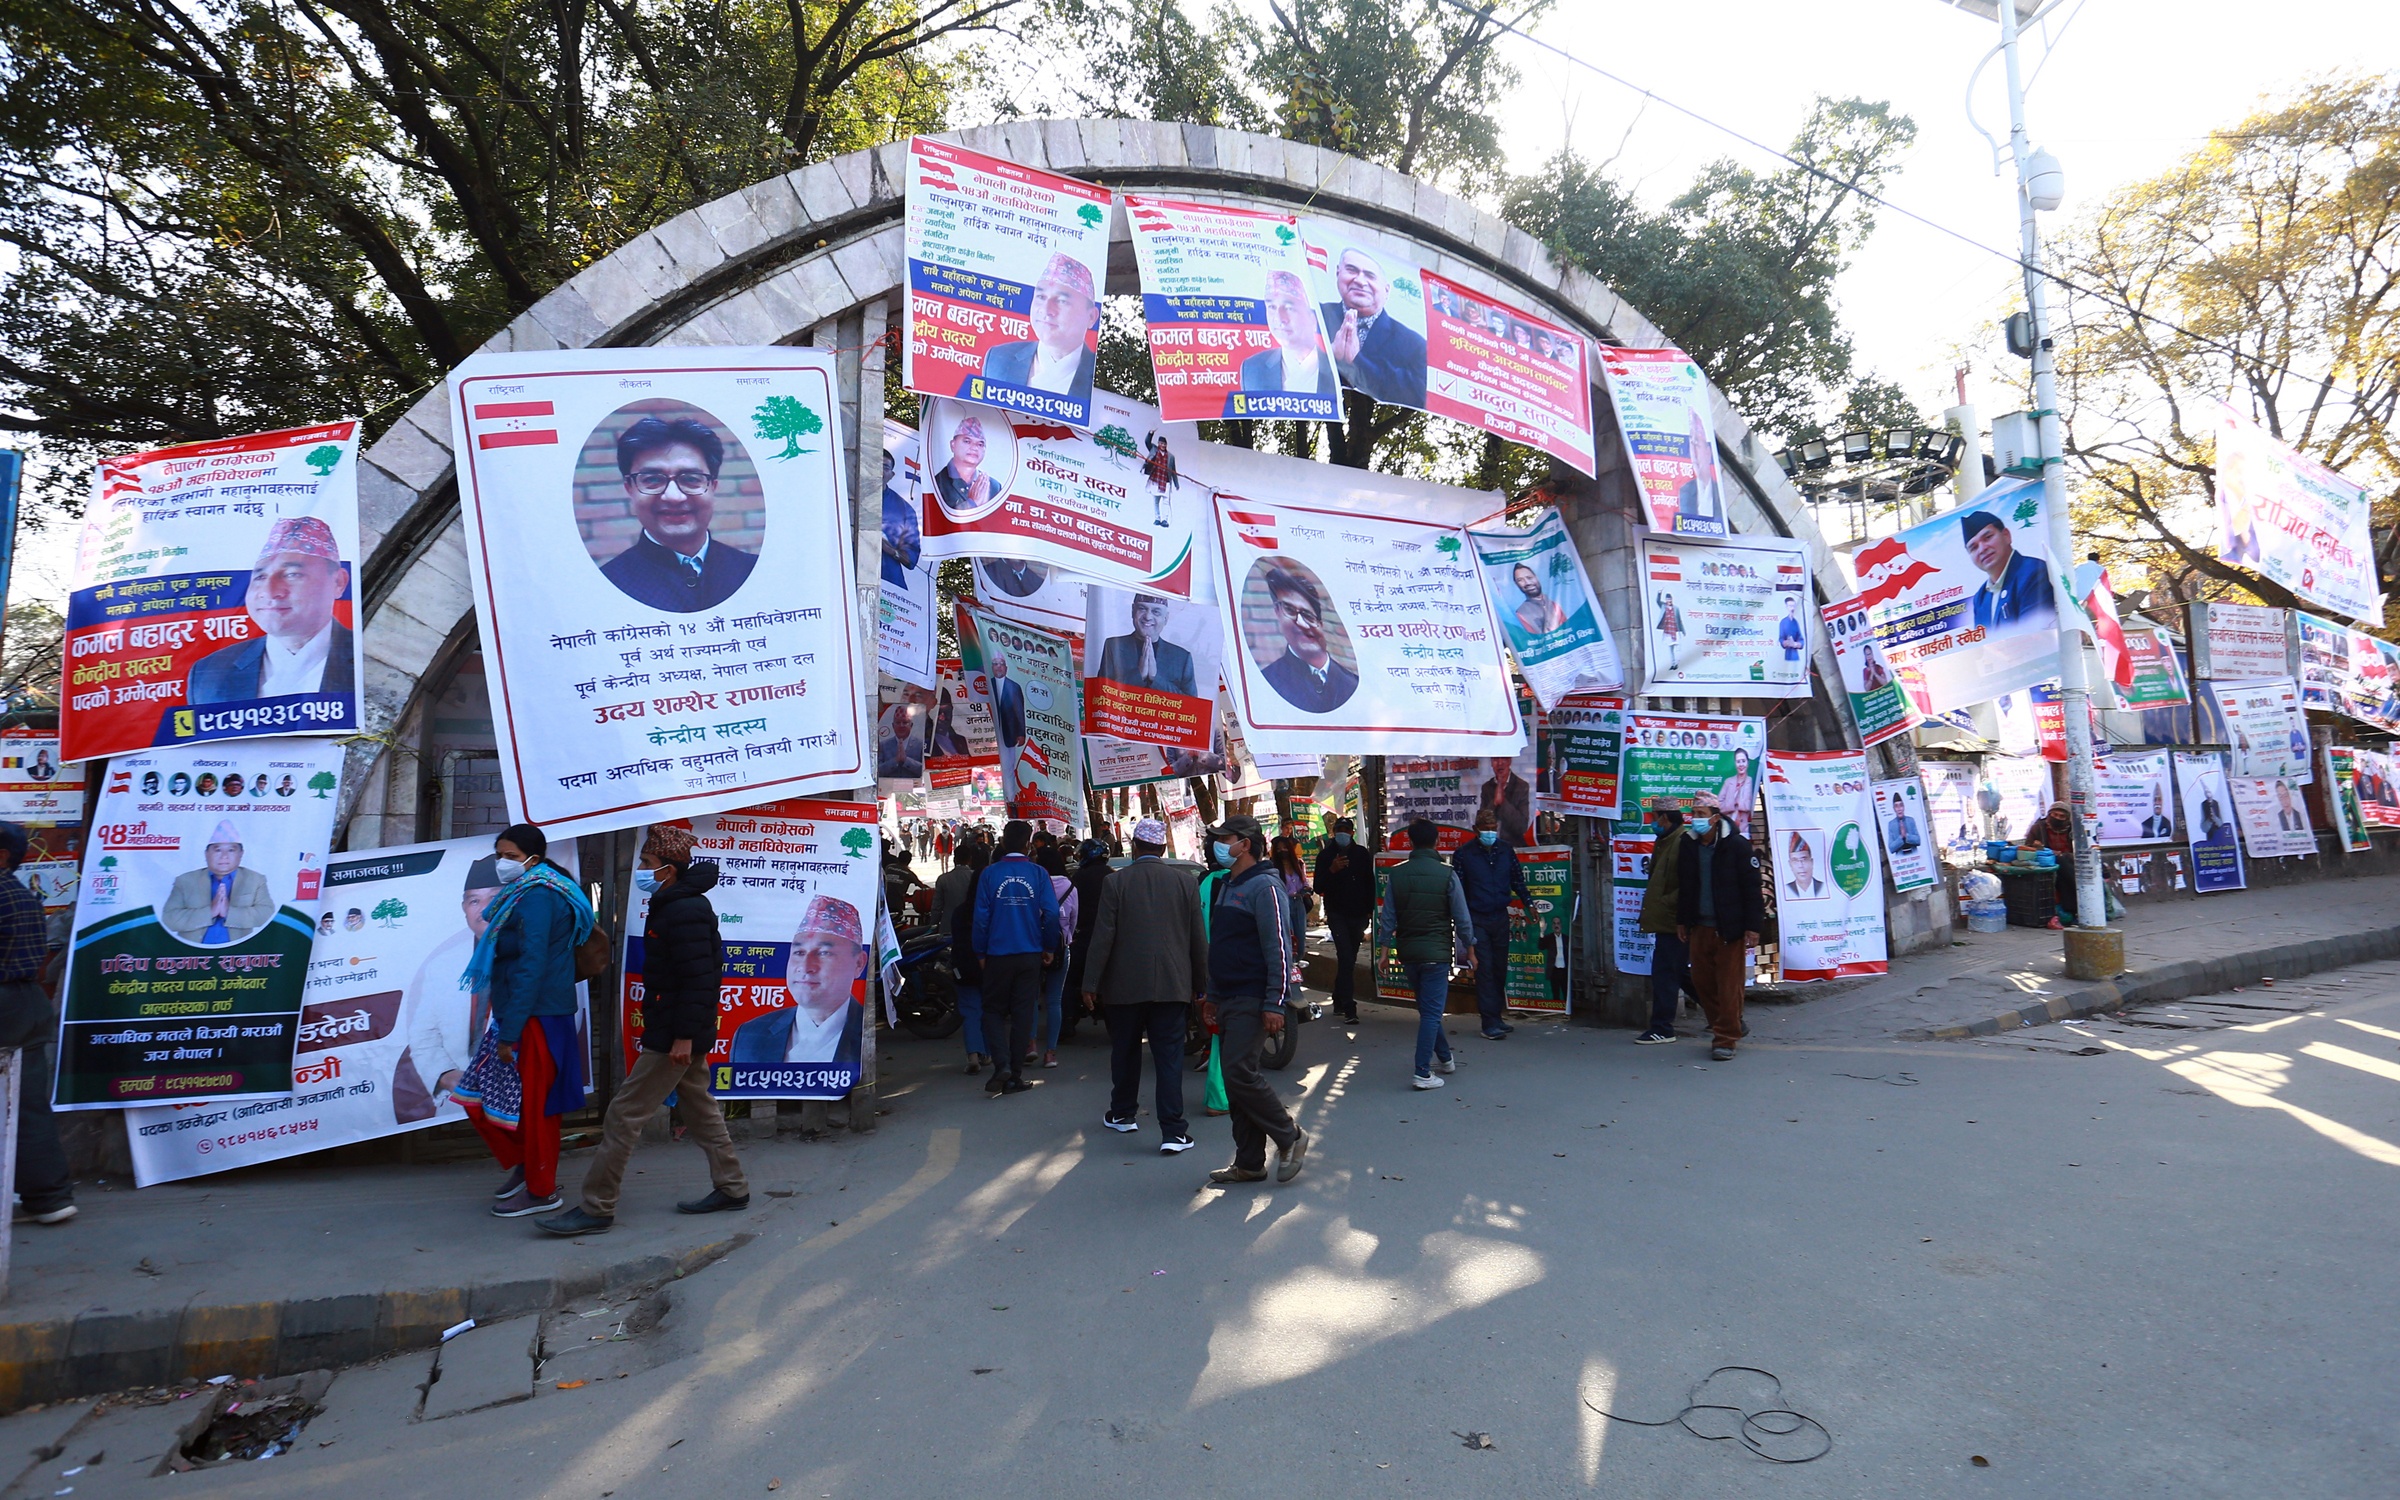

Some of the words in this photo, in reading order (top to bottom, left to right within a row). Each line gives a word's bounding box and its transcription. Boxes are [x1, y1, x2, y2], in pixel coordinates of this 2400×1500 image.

[973, 174, 1006, 191] नेपाली
[1010, 186, 1055, 205] कांग्रेसको
[929, 193, 977, 212] पाल्नुभएका
[982, 205, 1015, 221] सहभागी
[992, 194, 1058, 218] महाधिवेशनमा
[963, 215, 991, 230] हार्दिक
[995, 224, 1023, 238] स्वागत
[1027, 232, 1048, 248] गर्दछु
[947, 304, 997, 334] बहादुर
[1000, 316, 1030, 340] शाह
[941, 328, 977, 348] सदस्य
[1150, 328, 1193, 346] कमल
[1197, 328, 1242, 350] बहादुर
[1244, 330, 1272, 348] शाह
[1449, 335, 1490, 359] मुस्लिम
[1155, 349, 1194, 368] केन्द्रीय
[1196, 353, 1229, 366] सदस्य
[619, 378, 652, 388] लोकतन्त्र
[736, 377, 771, 386] समाजवाद
[1157, 368, 1188, 386] पदको
[986, 384, 1083, 419] ९८५१२३८१५४
[1248, 397, 1332, 415] ९८५१२३८१५४
[1468, 385, 1517, 413] अब्दुल
[1104, 405, 1131, 417] समाजवाद
[1484, 413, 1517, 434] विजयी
[163, 458, 206, 476] नेपाली
[211, 451, 275, 466] कांग्रेसको
[1038, 449, 1085, 468] महाधिवेशनमा
[186, 467, 278, 486] महाधिवेशनमा
[1026, 456, 1079, 483] केन्द्रिय
[1084, 476, 1127, 498] सदस्य
[170, 488, 215, 505] सहभागी
[1035, 478, 1066, 493] (प्रदेश)
[1072, 488, 1121, 513] उम्मेदवार
[143, 509, 181, 523] हार्दिक
[185, 503, 225, 518] स्वागत
[233, 500, 265, 517] गर्दछु
[1090, 506, 1107, 518] प्रदेश
[1005, 500, 1025, 514] मा.
[1030, 506, 1047, 519] डा.
[1051, 511, 1073, 527] रण
[1076, 517, 1114, 541] बहादुर
[1117, 532, 1150, 552] रावल
[1340, 533, 1374, 545] लोकतन्त्र
[1345, 558, 1367, 573] नेपाली
[95, 584, 115, 601] साथै
[170, 579, 191, 592] एक
[196, 576, 232, 590] अमूल्य
[105, 601, 138, 616] मतको
[141, 598, 176, 611] अपेक्षा
[179, 593, 208, 609] गर्दछु
[71, 628, 125, 658] कमल
[130, 620, 198, 649] बहादुर
[203, 615, 249, 640] शाह
[549, 629, 596, 650] नेपाली
[602, 621, 671, 642] कांग्रेसको
[678, 623, 696, 636] १४
[706, 616, 725, 632] औं
[730, 608, 821, 630] महाधिवेशनमा
[1357, 624, 1394, 638] उदय
[1397, 619, 1441, 639] शम्शेर
[1956, 624, 1987, 646] स्नेही
[619, 647, 641, 668] पूर्व
[650, 644, 674, 660] अर्थ
[679, 638, 741, 658] राज्यमन्त्री
[746, 636, 767, 650] एवं
[1400, 643, 1434, 659] केन्द्रीय
[73, 660, 122, 685] केन्द्रीय
[125, 655, 173, 677] सदस्य
[574, 677, 596, 699] पूर्व
[602, 672, 650, 690] केन्द्रीय
[659, 669, 706, 682] अध्यक्ष,
[712, 663, 748, 679] नेपाल
[752, 657, 787, 672] तरूण
[792, 652, 815, 665] दल
[72, 685, 111, 711] पदको
[1119, 690, 1142, 702] कुमार
[1411, 683, 1441, 695] विजयी
[593, 701, 645, 724] उदय
[652, 690, 718, 715] शम्शेर
[725, 679, 806, 706] राणालाई
[1112, 701, 1133, 712] सदस्य
[1135, 706, 1156, 717] पदमा
[2035, 705, 2059, 717] कमल
[199, 701, 344, 731] ९८५१२३८१५४
[1026, 709, 1074, 733] अत्याधिक
[646, 724, 706, 746] केन्द्रीय
[716, 717, 767, 737] सदस्य
[558, 771, 597, 790] पदमा
[606, 758, 674, 780] अत्यधिक
[679, 746, 739, 768] वहुमतले
[744, 737, 792, 760] विजयी
[684, 778, 703, 788] जय
[706, 771, 737, 787] नेपाल
[825, 808, 859, 818] समाजवाद
[98, 824, 127, 845] १४
[716, 817, 757, 833] नेपाली
[760, 821, 815, 836] कांग्रेसको
[128, 835, 181, 846] महाधिवेशन
[738, 838, 818, 854] महाधिवेशनमा
[331, 864, 390, 881] समाजवाद
[726, 856, 766, 870] सहभागी
[771, 860, 850, 875] महानुभावहरुलाई
[302, 881, 317, 889] VOTE
[996, 877, 1016, 898] KANTIPUR
[1015, 877, 1035, 899] ACADEMY
[317, 958, 344, 968] भन्दा
[726, 946, 743, 958] एक
[747, 946, 776, 959] अमूल्य
[101, 953, 152, 974] प्रदिप
[155, 956, 214, 975] कुमार
[218, 953, 284, 973] सुनुवार
[109, 979, 149, 995] केन्द्रीय
[151, 981, 186, 993] सदस्य
[188, 976, 218, 991] पदको
[220, 975, 268, 990] उम्मेदवार
[314, 973, 333, 987] मेरो
[212, 997, 233, 1012] तर्फ
[750, 985, 787, 1008] शाह
[90, 1029, 154, 1045] अत्याधिक
[156, 1027, 193, 1041] मतले
[196, 1025, 239, 1040] विजयी
[143, 1050, 169, 1063] जय
[174, 1047, 213, 1061] नेपाल
[119, 1075, 156, 1093] सम्पर्क
[734, 1068, 851, 1090] ९८५१२३८१५४
[139, 1122, 173, 1138] पदका
[232, 1098, 292, 1120] (आदिवासी
[296, 1086, 345, 1106] जनजाती
[348, 1080, 375, 1096] तर्फ)
[217, 1118, 318, 1149] ९८४१४६८५४५
